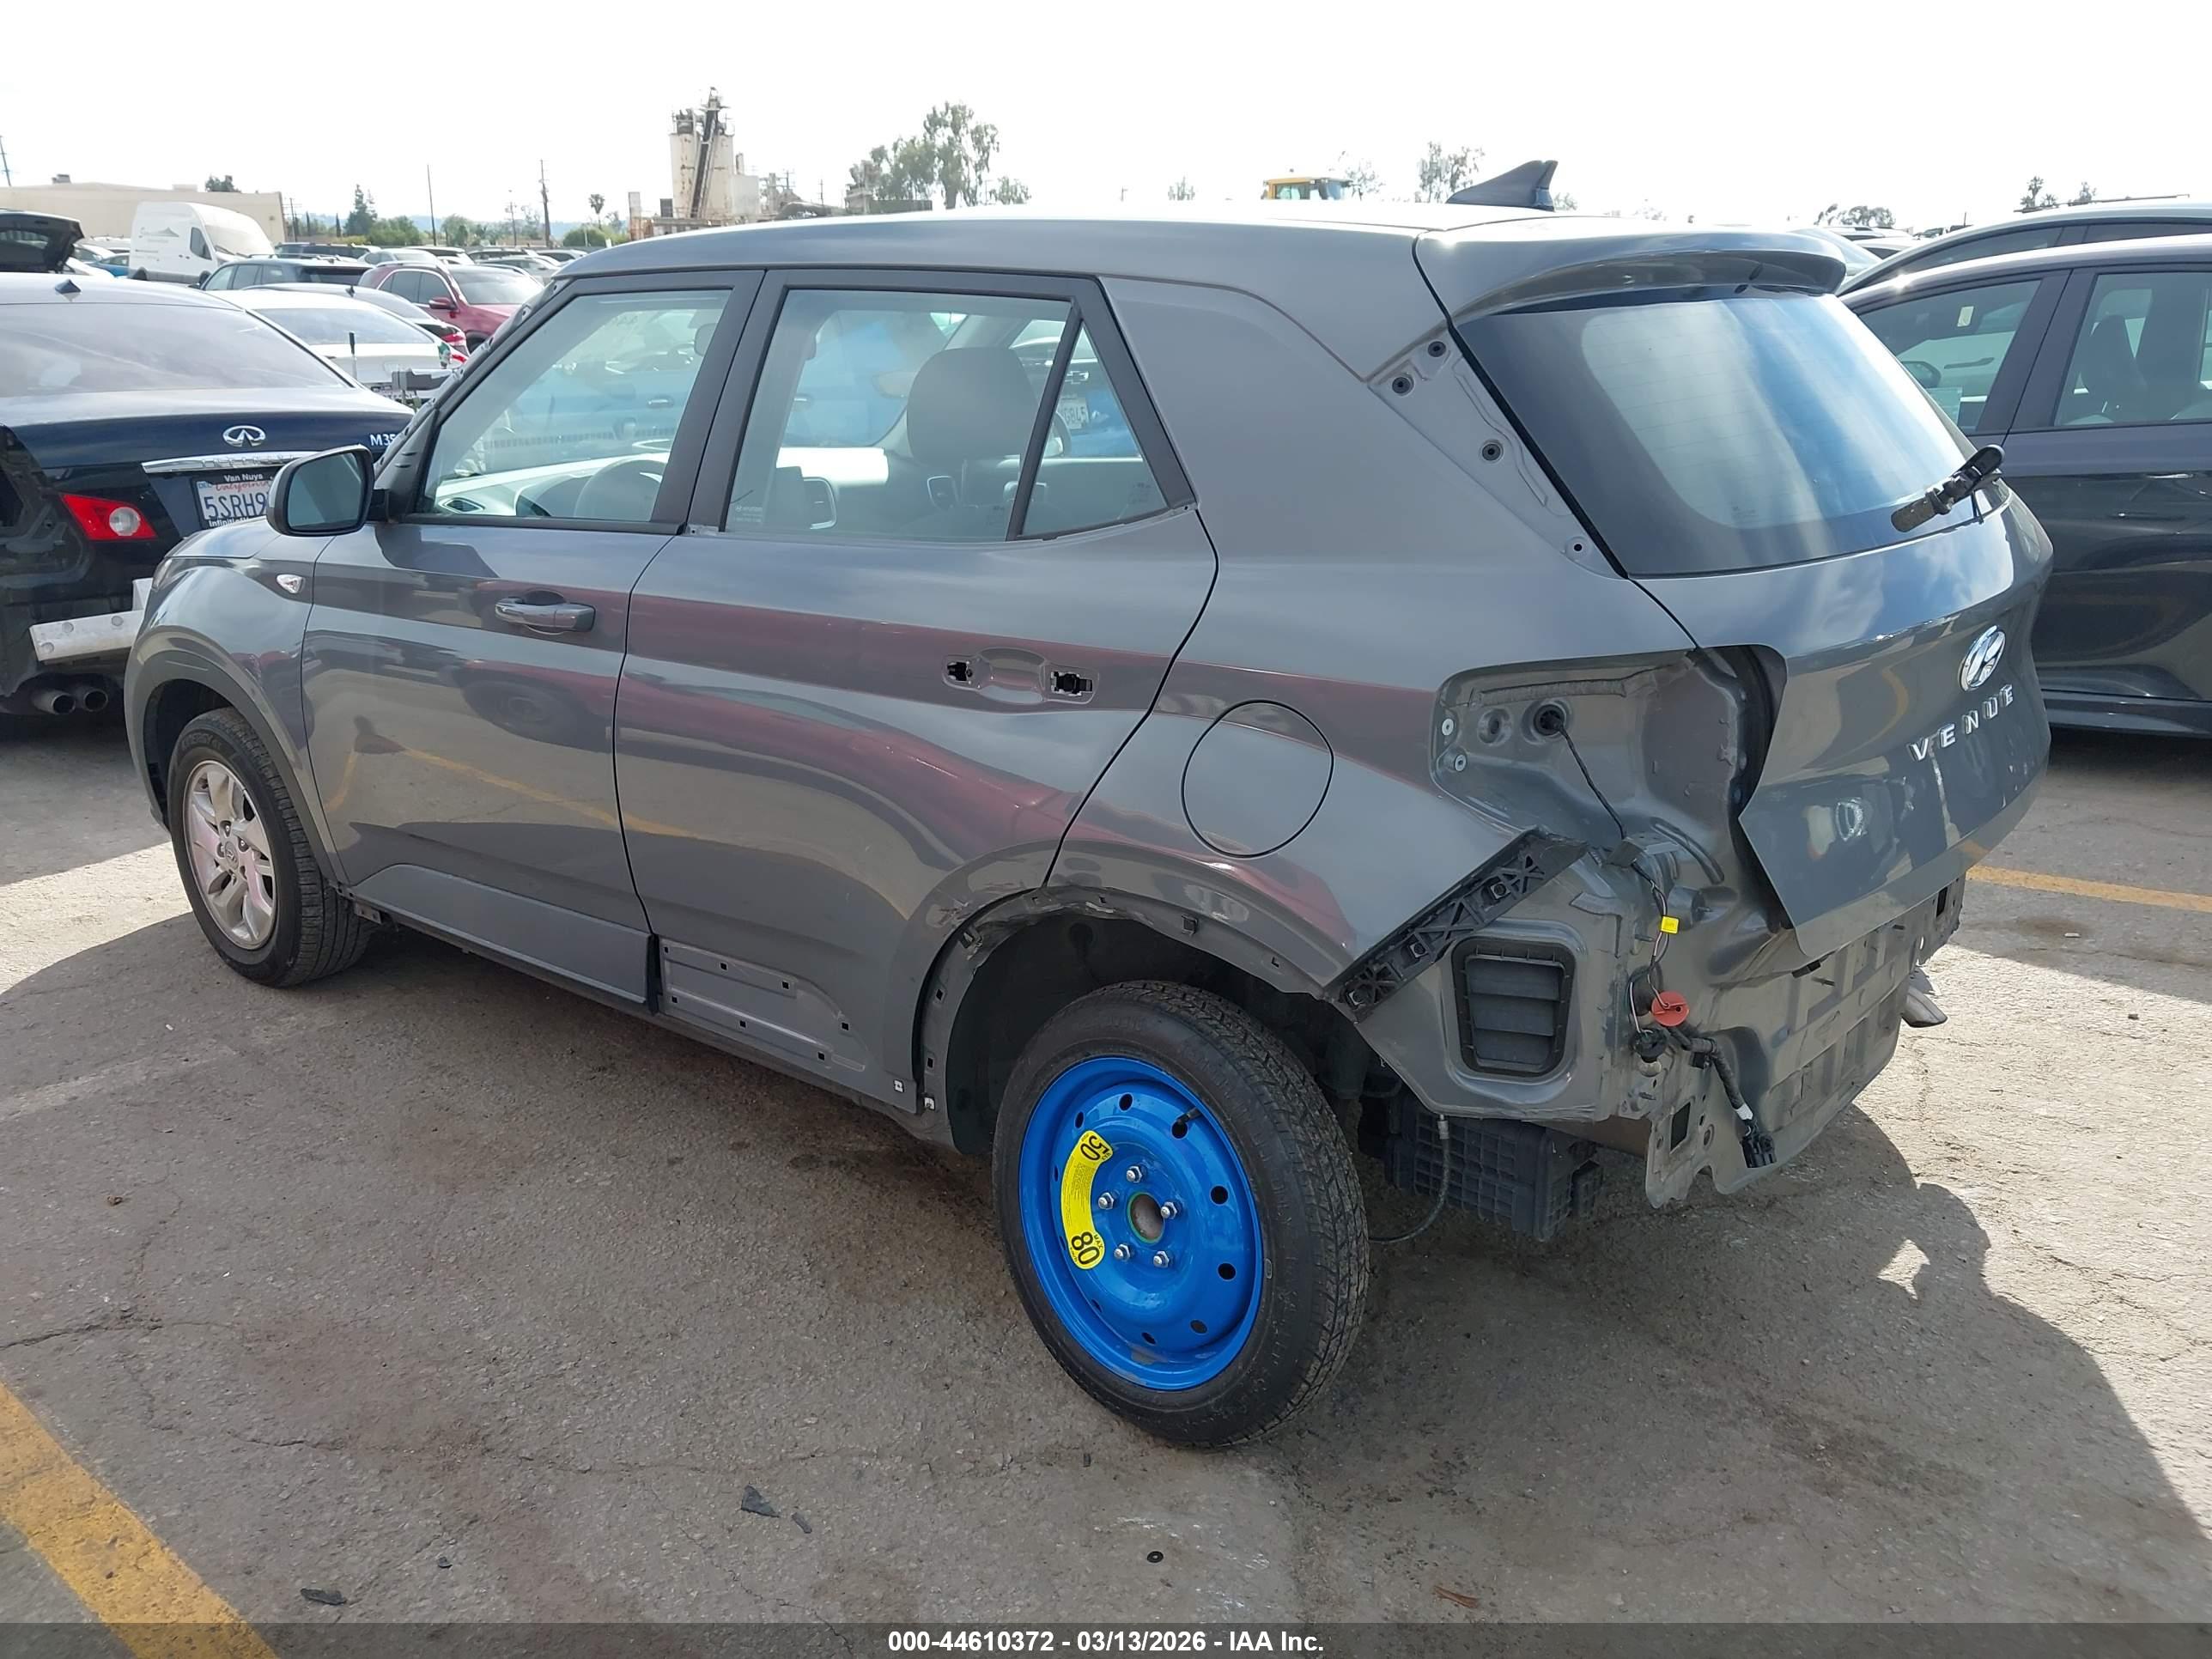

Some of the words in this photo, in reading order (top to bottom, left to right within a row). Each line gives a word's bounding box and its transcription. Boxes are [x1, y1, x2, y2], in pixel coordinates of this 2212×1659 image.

[204, 492, 267, 520] 5SRH9
[1905, 684, 2014, 761] VENUE
[1080, 1135, 1110, 1161] 50
[1071, 1231, 1100, 1265] 80
